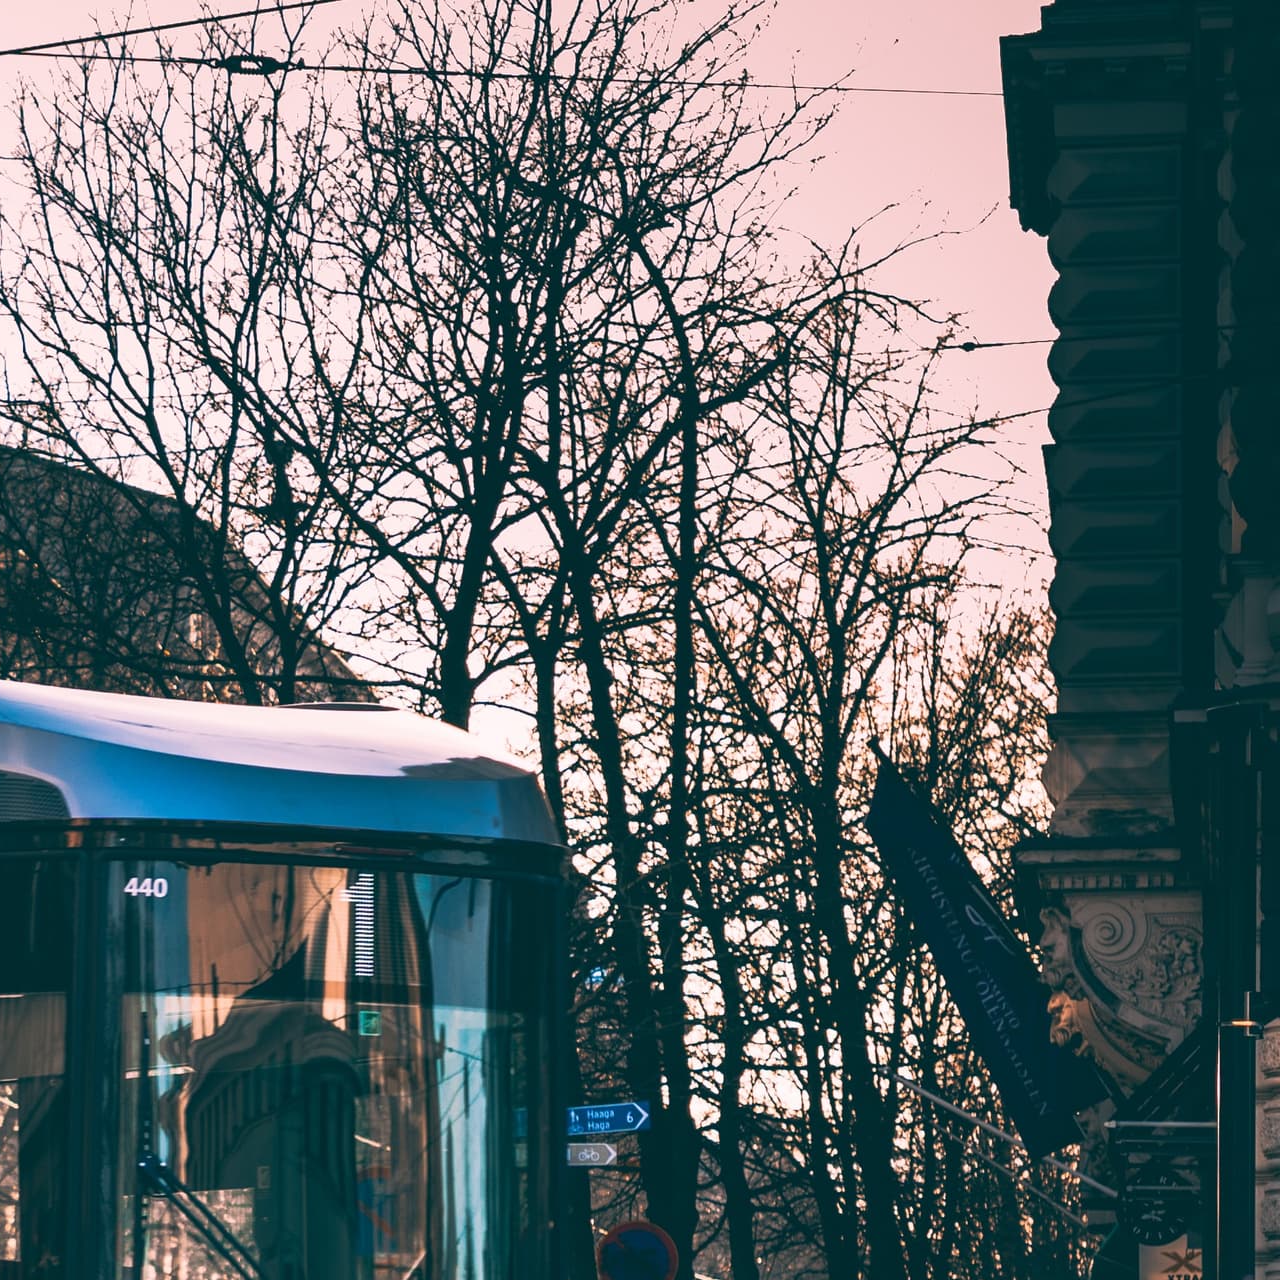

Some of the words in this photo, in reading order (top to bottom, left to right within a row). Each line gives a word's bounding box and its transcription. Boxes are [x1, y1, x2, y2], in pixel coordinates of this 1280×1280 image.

[123, 877, 169, 898] 440
[338, 873, 375, 977] 1
[587, 1109, 615, 1121] Haaga
[626, 1112, 634, 1123] 6
[587, 1121, 611, 1131] Haga
